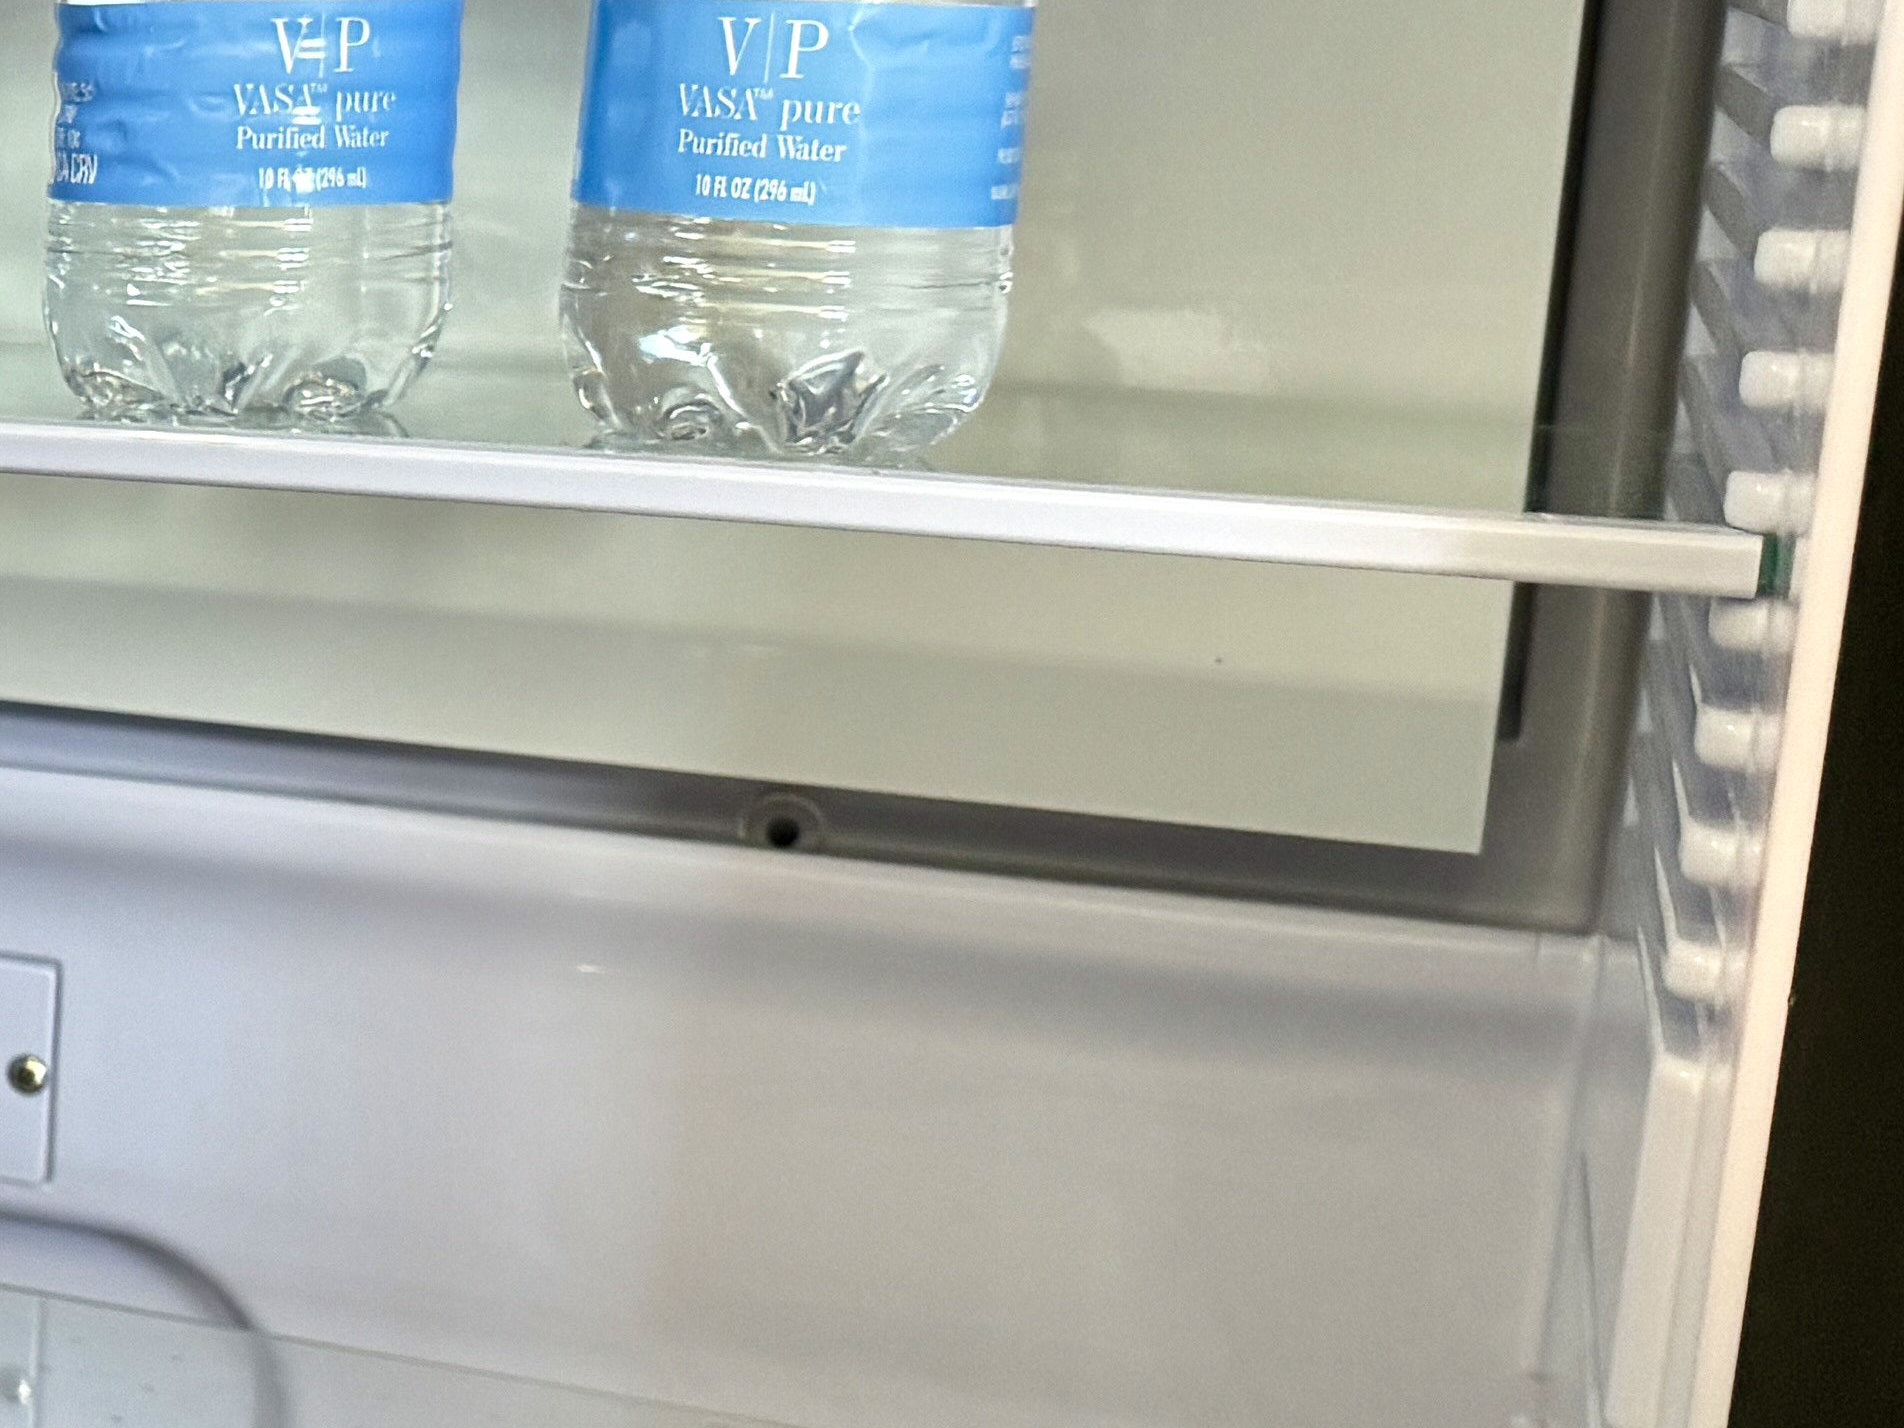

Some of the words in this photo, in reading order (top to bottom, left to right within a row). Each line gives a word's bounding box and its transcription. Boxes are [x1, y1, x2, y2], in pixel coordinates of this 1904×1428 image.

[335, 90, 398, 123] pure
[779, 98, 861, 132] pure
[235, 124, 326, 150] Purified
[334, 124, 390, 149] Water
[677, 128, 767, 159] Purified
[777, 134, 848, 162] Water
[258, 167, 275, 190] 10
[695, 173, 711, 196] 10
[731, 176, 752, 201] OZ
[754, 178, 787, 203] (296
